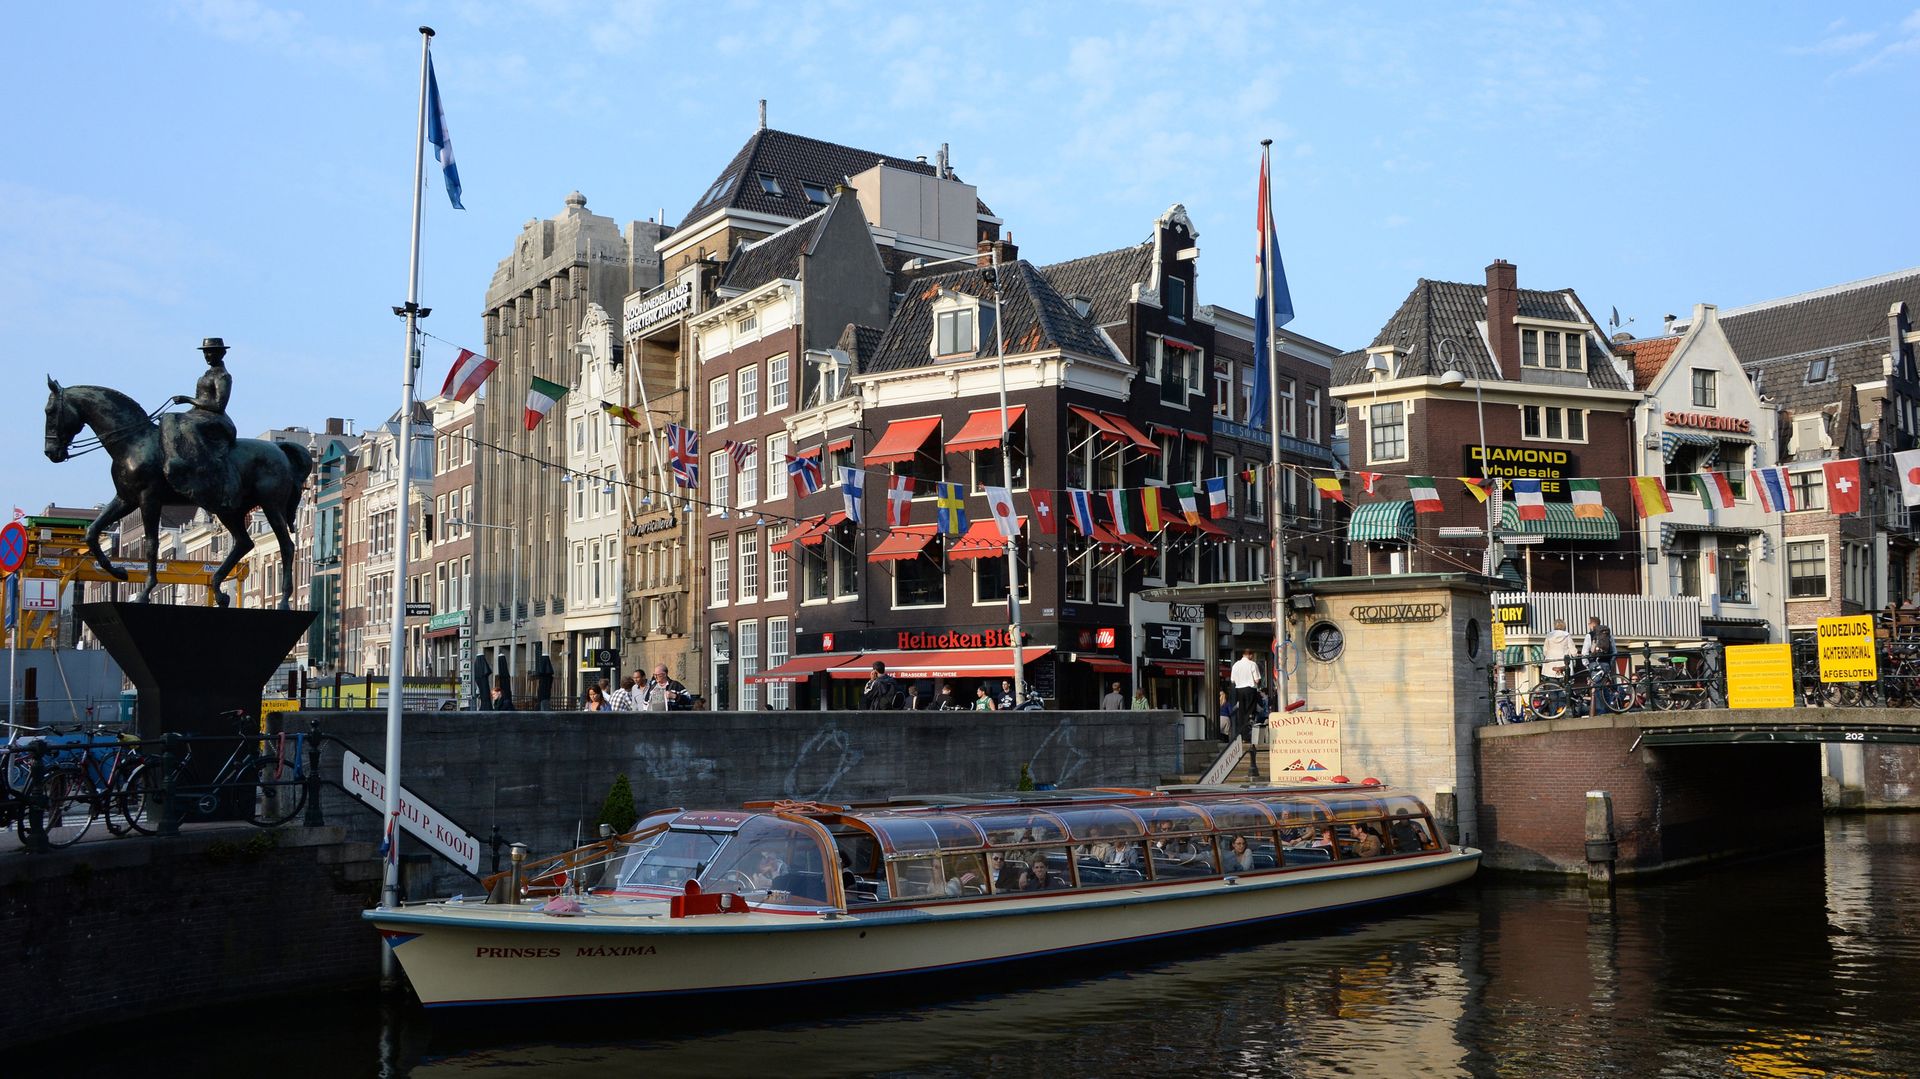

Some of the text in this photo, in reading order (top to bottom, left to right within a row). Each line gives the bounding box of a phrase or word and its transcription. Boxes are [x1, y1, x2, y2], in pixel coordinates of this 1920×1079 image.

[1664, 411, 1751, 432] SOUVENIRS
[1279, 438, 1323, 456] UWELIER
[1471, 447, 1567, 464] DIAMOND
[1481, 465, 1560, 478] wholesale
[1359, 604, 1435, 619] RONDVAART
[1820, 622, 1870, 637] OUDEZIJDS-
[897, 629, 1026, 649] Heineken Bie
[1098, 630, 1114, 647] illy
[1823, 646, 1871, 660] ACHTERBURGWAL
[1823, 669, 1874, 678] AFGESLOTEN
[1271, 716, 1338, 729] RONDVAART
[436, 823, 474, 860] KOOIJ
[476, 947, 561, 958] PRINSES
